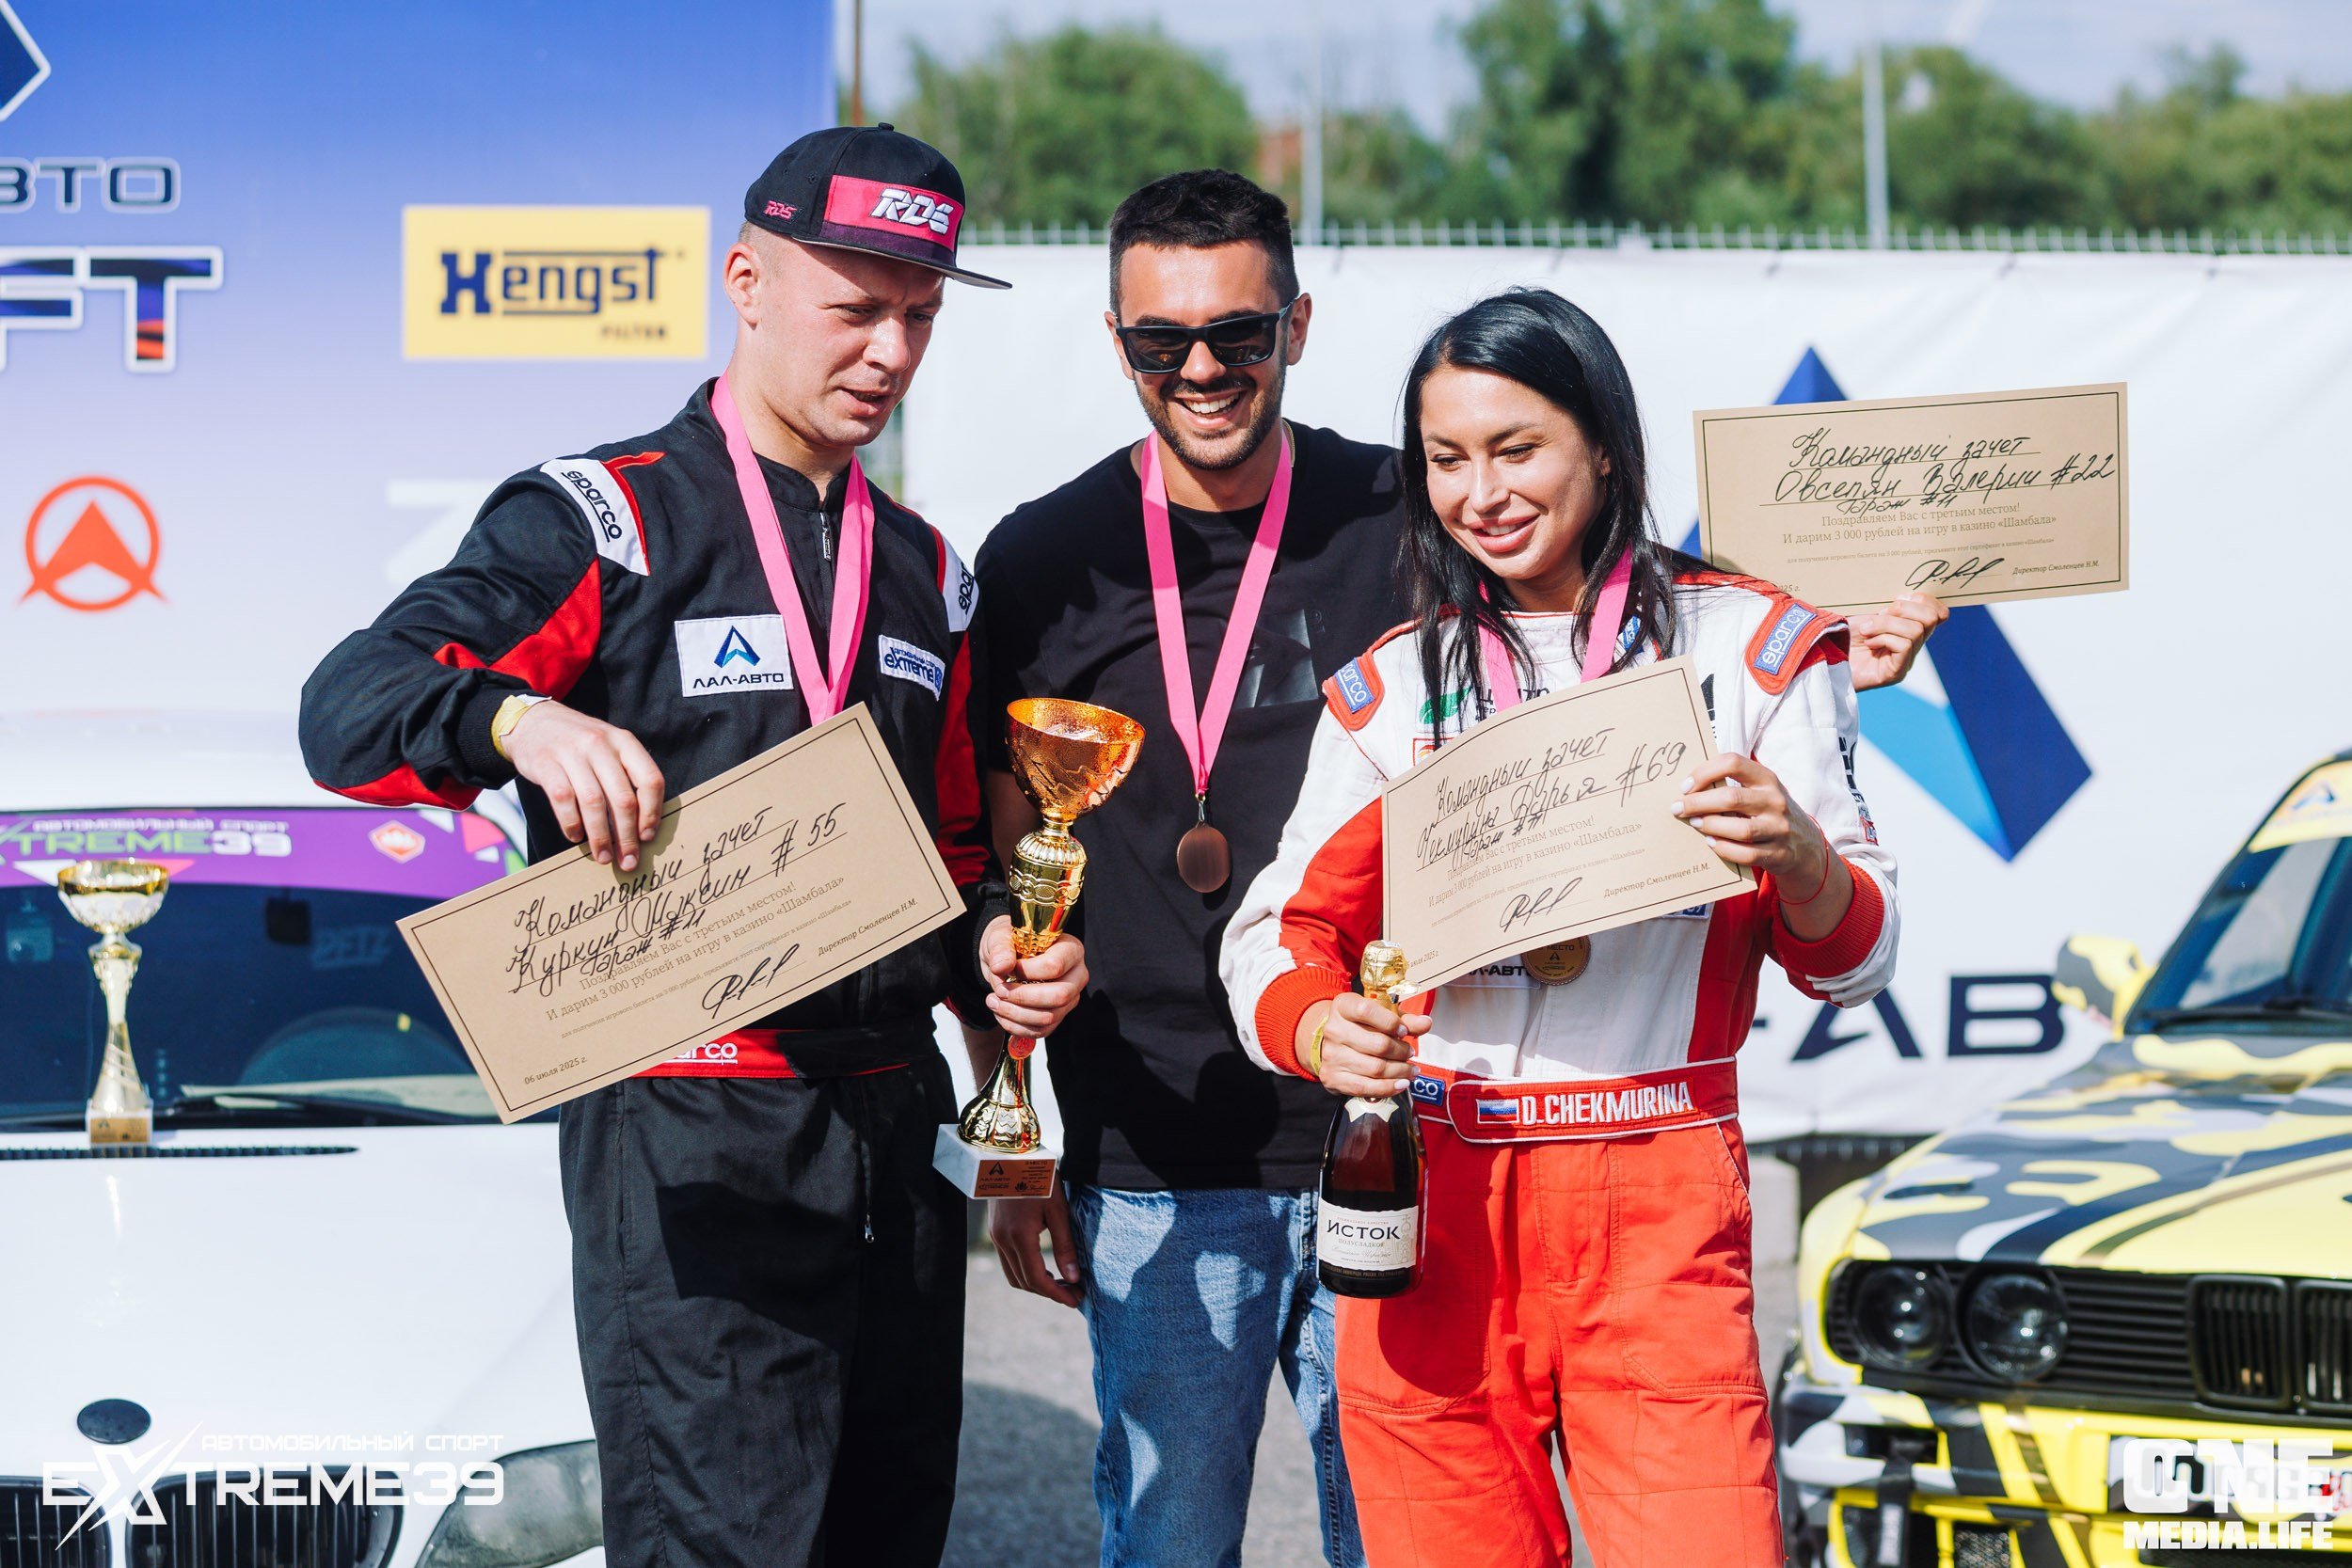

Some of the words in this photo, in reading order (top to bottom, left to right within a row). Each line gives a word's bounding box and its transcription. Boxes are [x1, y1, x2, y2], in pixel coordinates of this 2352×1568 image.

[764, 200, 797, 220] RDS
[871, 188, 954, 234] RDS
[439, 247, 674, 317] Hengst
[1775, 467, 1901, 501] Овсепян
[2050, 453, 2115, 489] #22
[564, 469, 622, 542] sparco
[1821, 512, 1896, 527] Поздравляем
[1899, 510, 1919, 521] Вас
[1930, 508, 1975, 521] третьим
[1978, 502, 2020, 515] местом!
[1782, 533, 1792, 544] И
[1794, 532, 1832, 545] дарим
[1834, 531, 1840, 540] 3
[1843, 529, 1862, 540] 000
[1865, 526, 1904, 541] рублей
[1907, 527, 1920, 535] на
[1923, 524, 1948, 535] игру
[1959, 520, 1995, 531] казино
[1997, 515, 2057, 528] «Шамбала»
[1778, 583, 1793, 593] 025
[1762, 607, 1808, 665] sparco
[1342, 662, 1367, 703] arco
[1485, 847, 1499, 860] Вас
[1499, 846, 1504, 854] с
[1504, 831, 1547, 852] третьим
[1549, 814, 1595, 837] местом!
[1428, 895, 1434, 907] И
[1454, 883, 1457, 894] 3
[1467, 865, 1490, 888] рублей
[1491, 862, 1502, 874] на
[1502, 855, 1523, 870] игру
[1525, 852, 1532, 862] в
[1534, 840, 1571, 859] казино
[1572, 822, 1642, 847] «Шамбала»
[1603, 879, 1645, 898] Директор
[1645, 868, 1692, 886] Смоленцев
[1691, 862, 1710, 874] Н.М.
[545, 1008, 559, 1021] И
[559, 993, 599, 1017] дарим
[598, 988, 609, 999] 3
[608, 978, 630, 995] 000
[630, 958, 675, 988] рублей
[675, 952, 691, 965] на
[691, 937, 719, 957] игру
[723, 933, 732, 942] в
[731, 911, 775, 938] казино
[775, 876, 845, 916] «Шамбала»
[579, 948, 660, 990] Поздравляем
[660, 935, 685, 955] Вас
[683, 934, 692, 943] с
[692, 908, 745, 939] третьим
[745, 880, 797, 913] местом!
[818, 930, 856, 957] Директор
[856, 907, 900, 934] Смоленцев
[898, 896, 918, 911] Н.М.
[522, 1073, 536, 1085] 06
[534, 1067, 559, 1081] июля
[557, 1056, 580, 1071] 2025
[1327, 1219, 1401, 1240] ИСТОК
